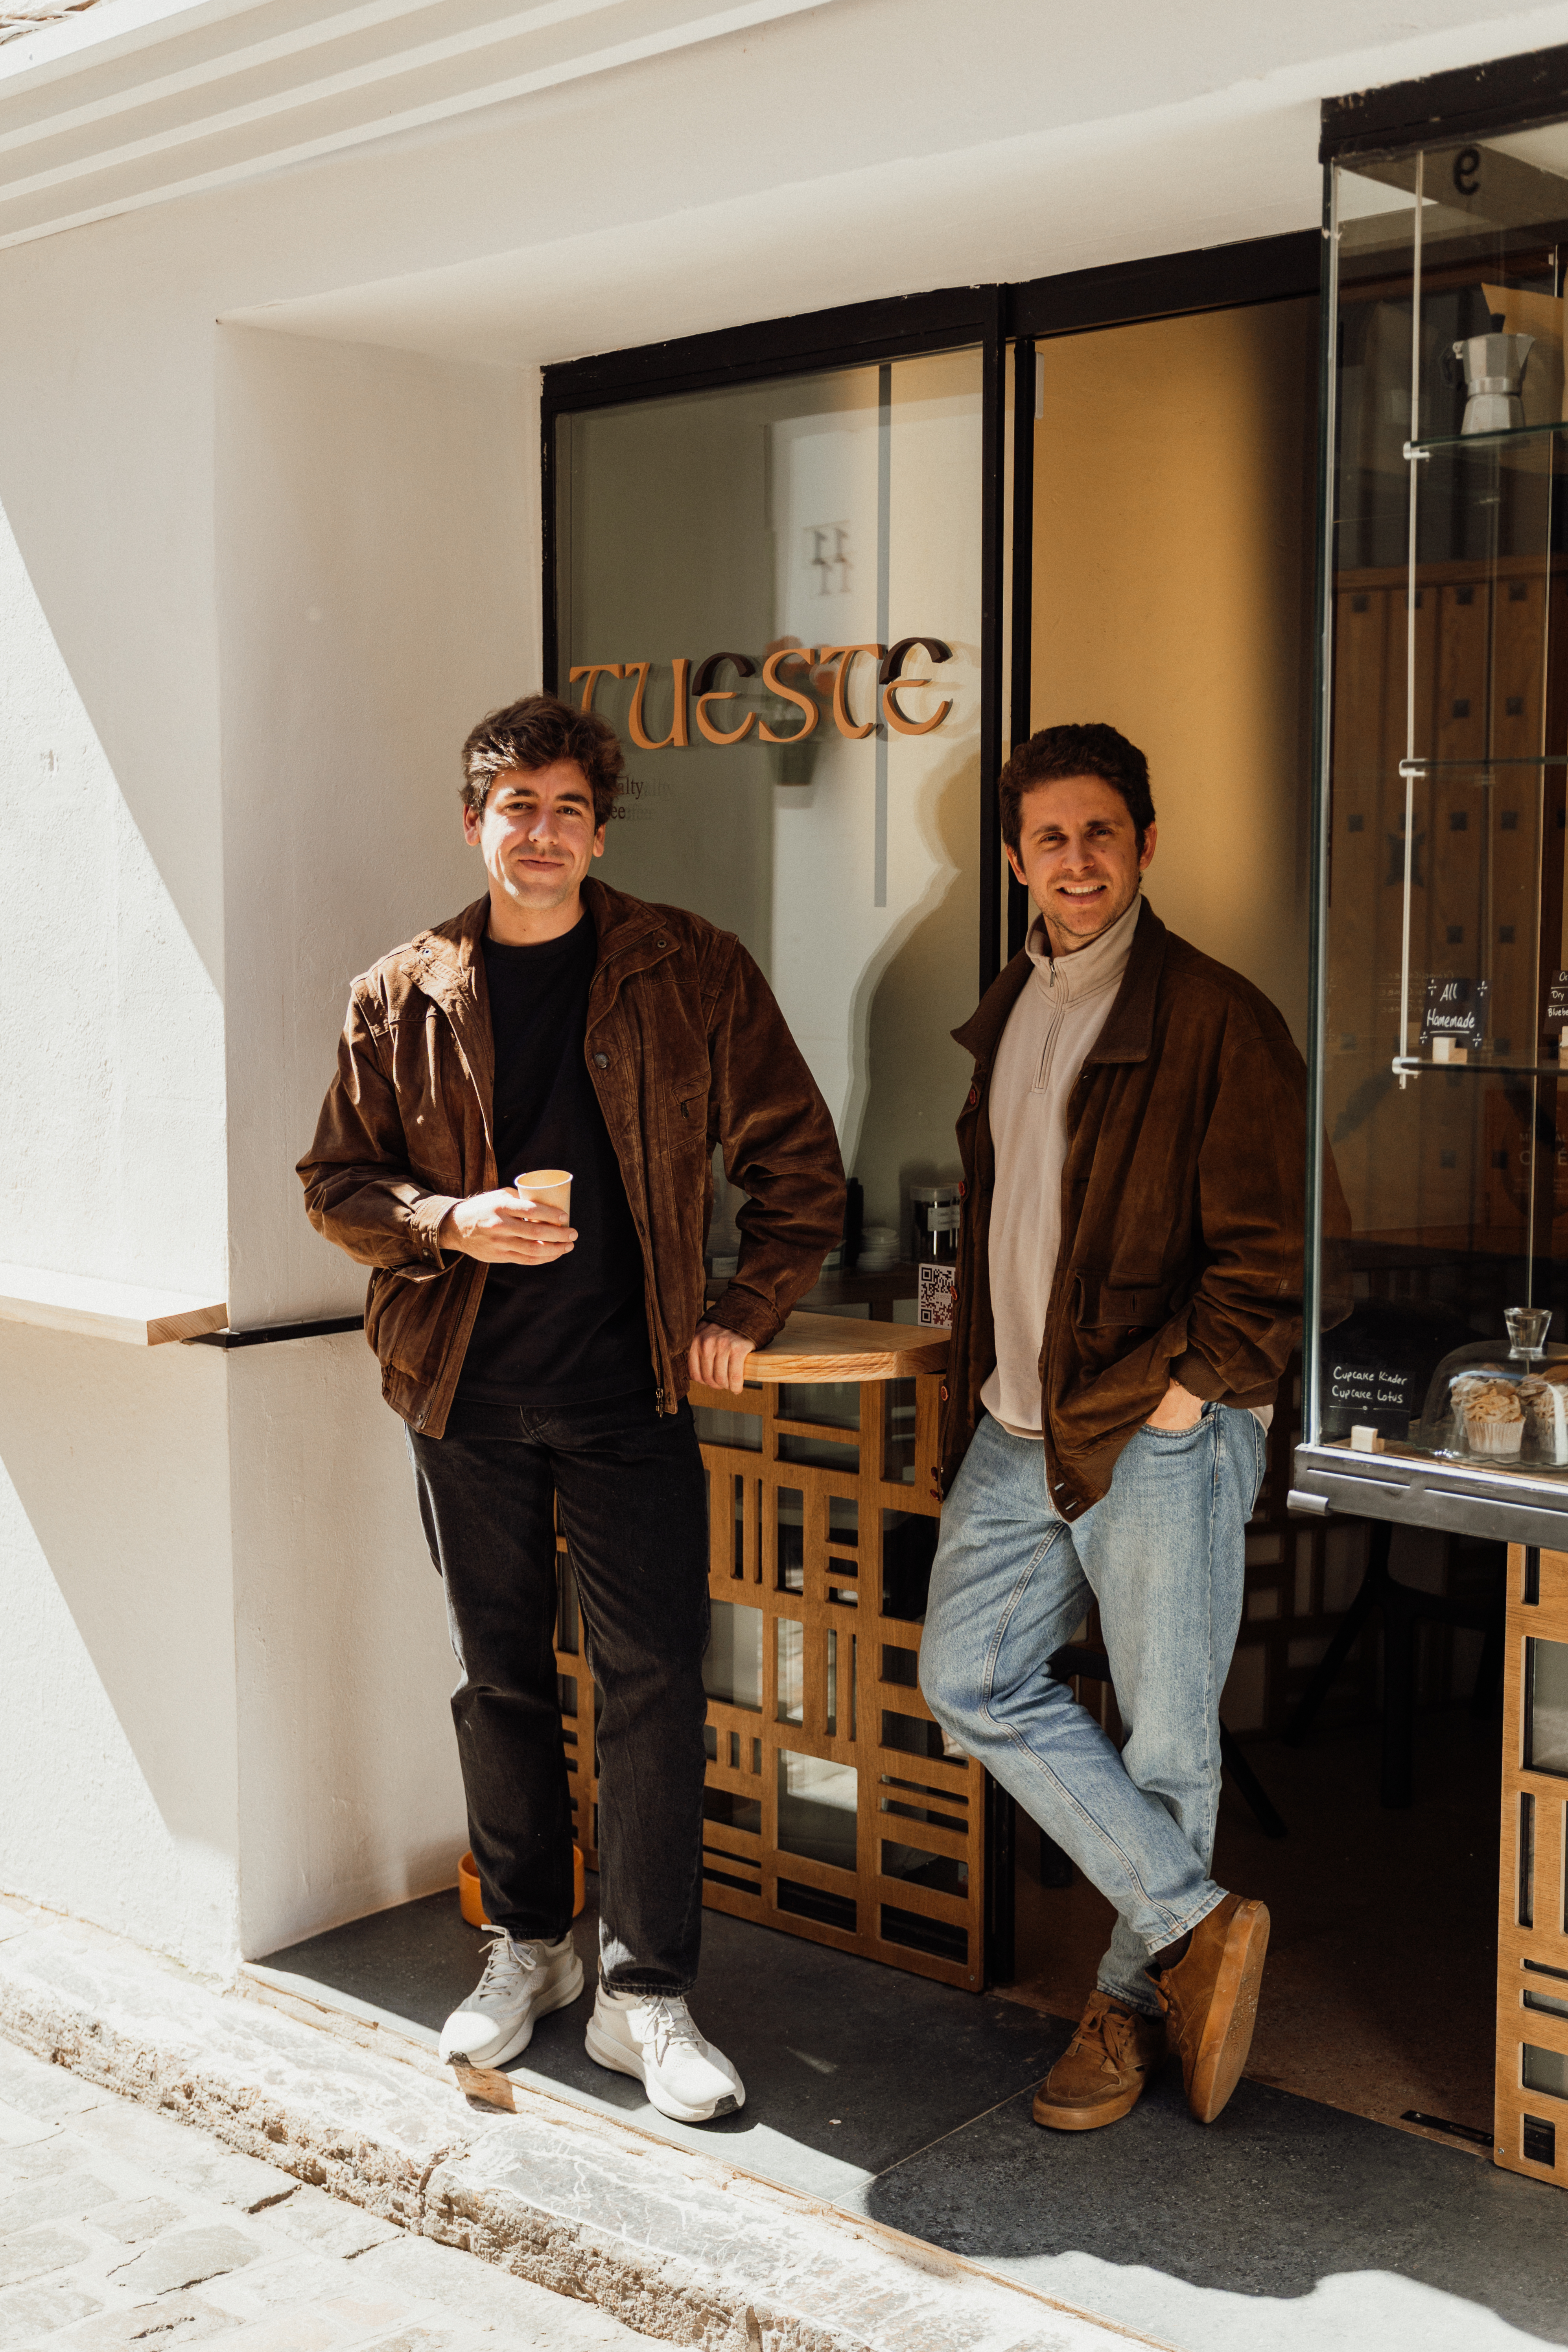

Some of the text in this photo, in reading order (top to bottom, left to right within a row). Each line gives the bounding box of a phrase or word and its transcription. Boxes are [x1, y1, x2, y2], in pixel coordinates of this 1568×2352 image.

[569, 636, 953, 749] TUESTE
[1439, 983, 1457, 1001] All
[1551, 990, 1564, 1001] Dry
[1426, 1008, 1475, 1028] Homemade
[1548, 1007, 1568, 1017] Bluebe
[1333, 1366, 1408, 1385] Cupcake Kinder
[1332, 1385, 1403, 1403] Cupcake Lotus
